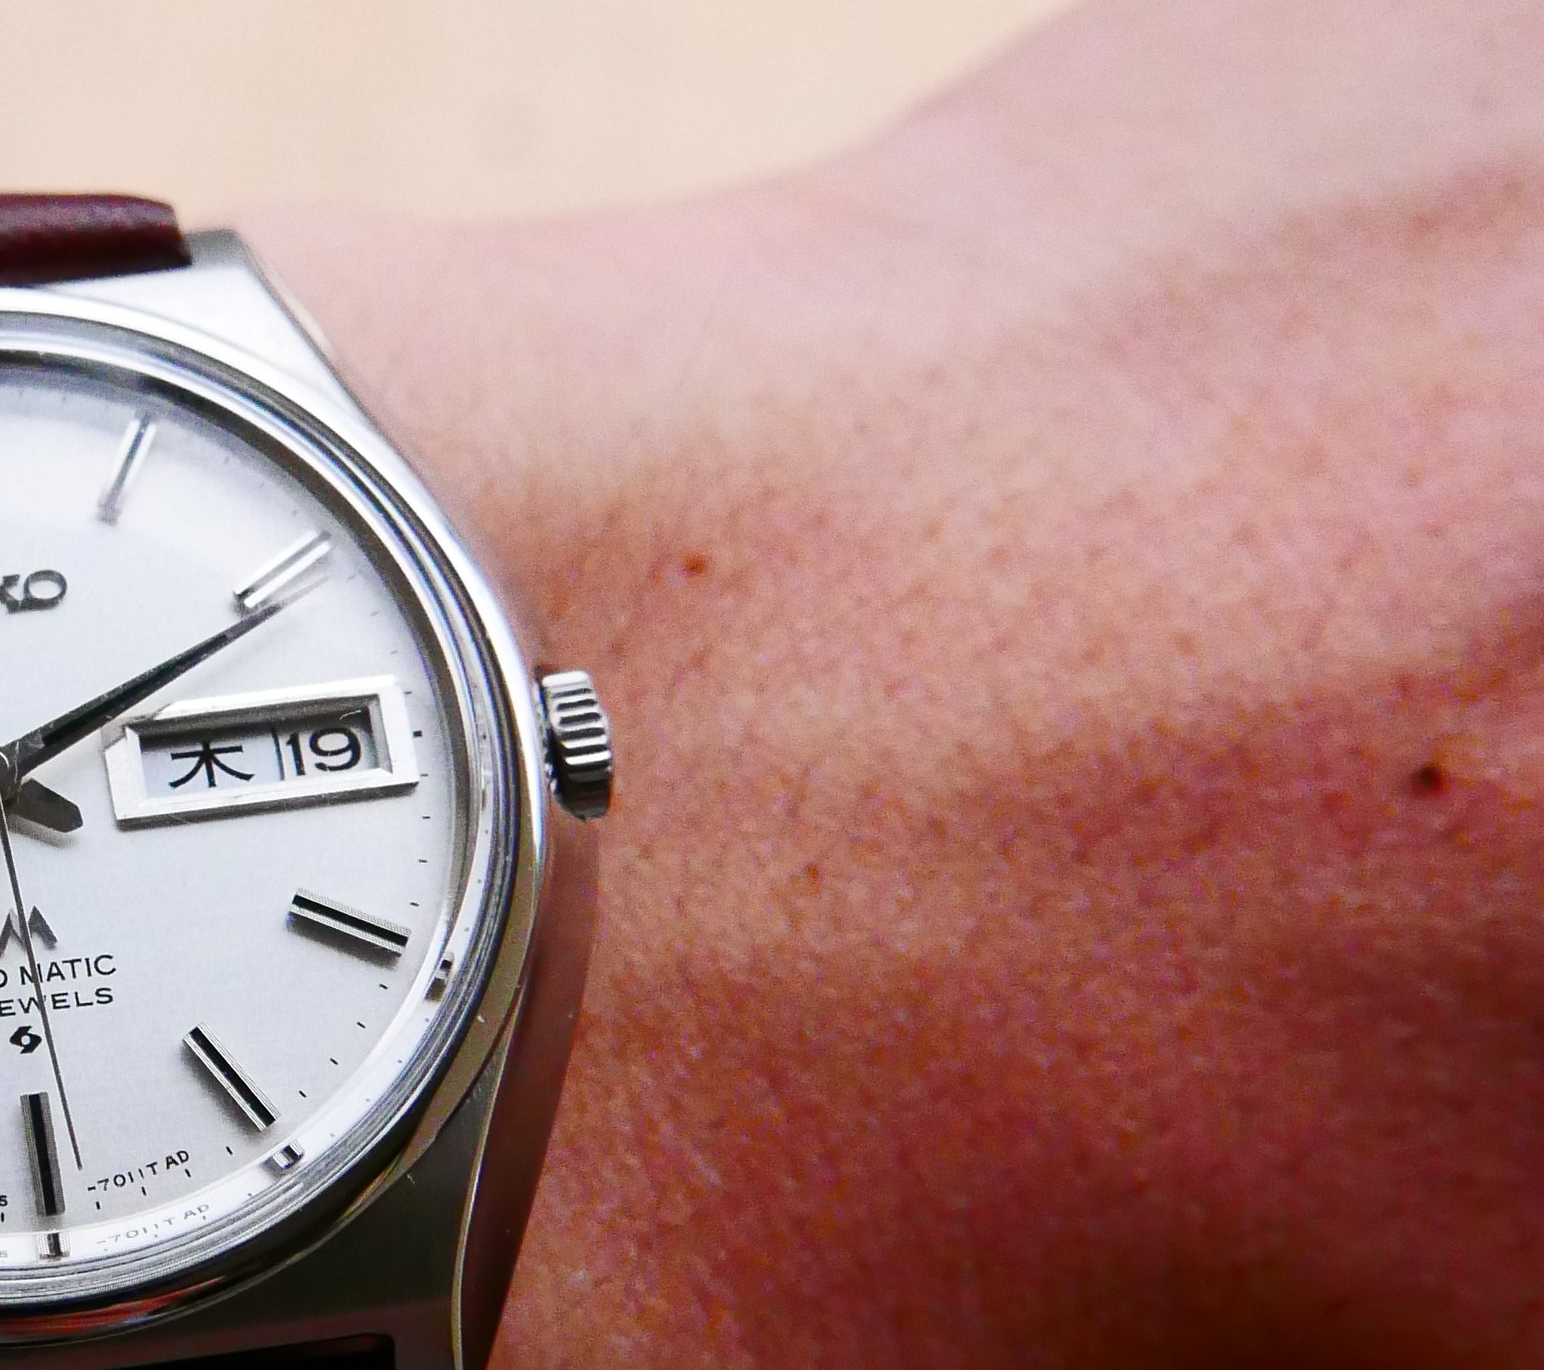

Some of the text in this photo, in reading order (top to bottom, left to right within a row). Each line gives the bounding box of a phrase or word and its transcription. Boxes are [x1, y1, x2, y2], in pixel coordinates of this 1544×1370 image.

[169, 728, 362, 788] 木 19
[19, 955, 117, 985] MATIC
